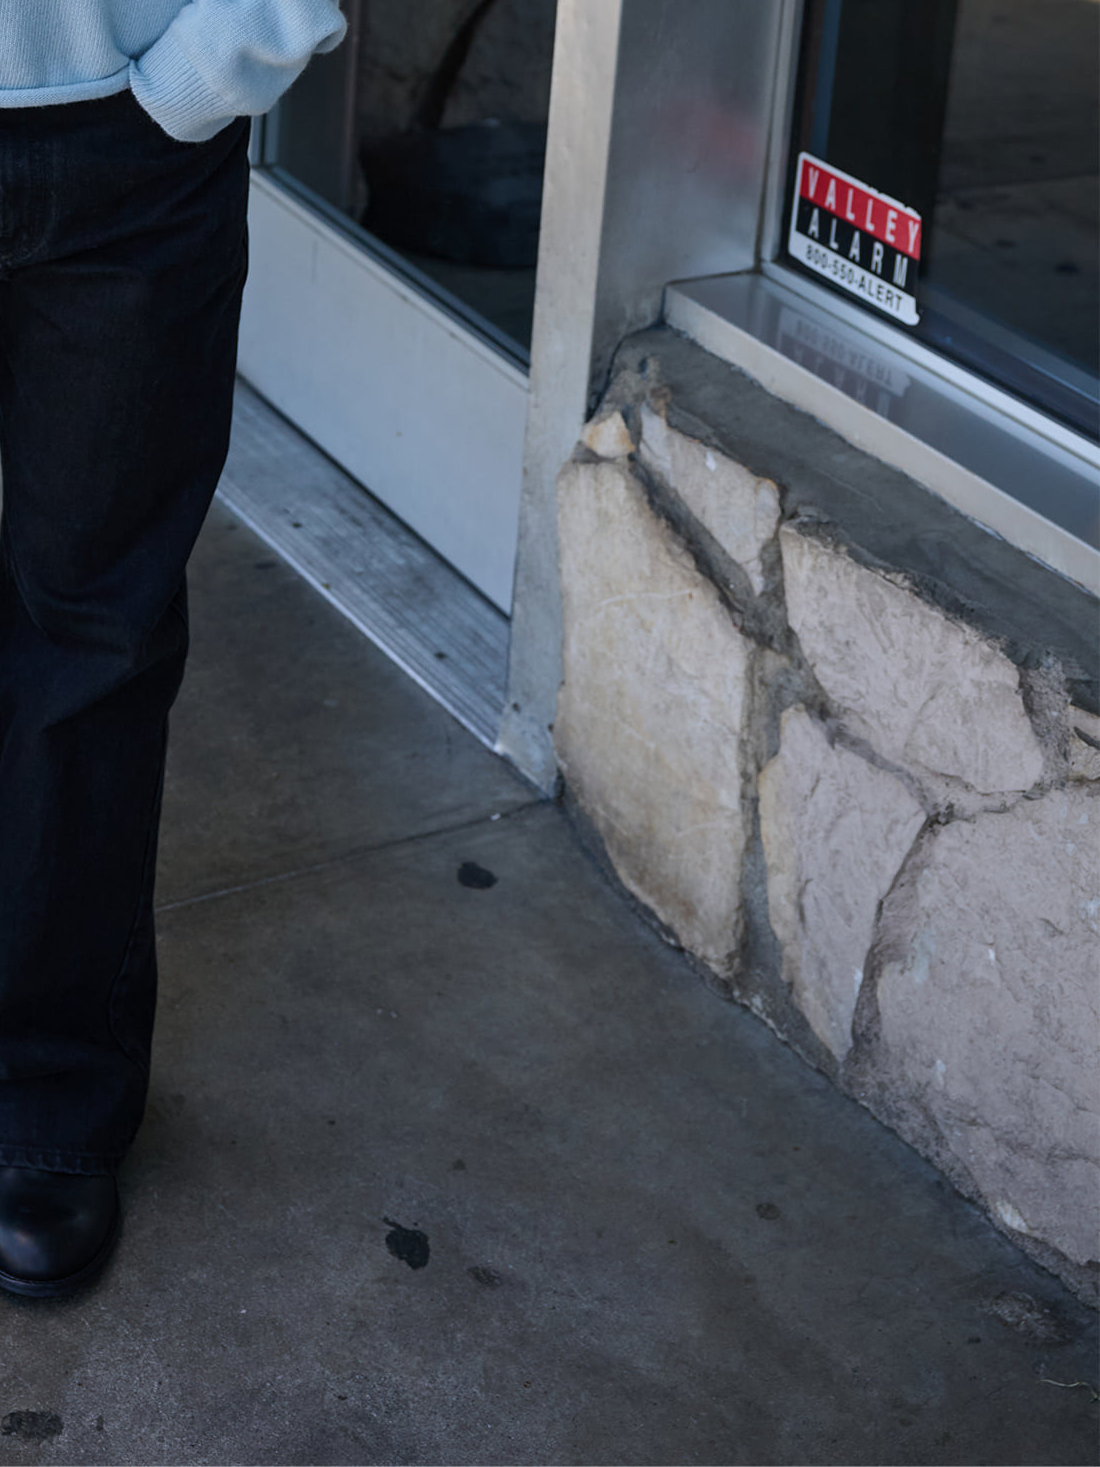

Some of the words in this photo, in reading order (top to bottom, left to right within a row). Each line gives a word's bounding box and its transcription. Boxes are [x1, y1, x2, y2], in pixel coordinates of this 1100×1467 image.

[808, 167, 920, 253] VALLEY
[808, 208, 909, 289] ALARM
[804, 244, 903, 312] 800-550-ALERT
